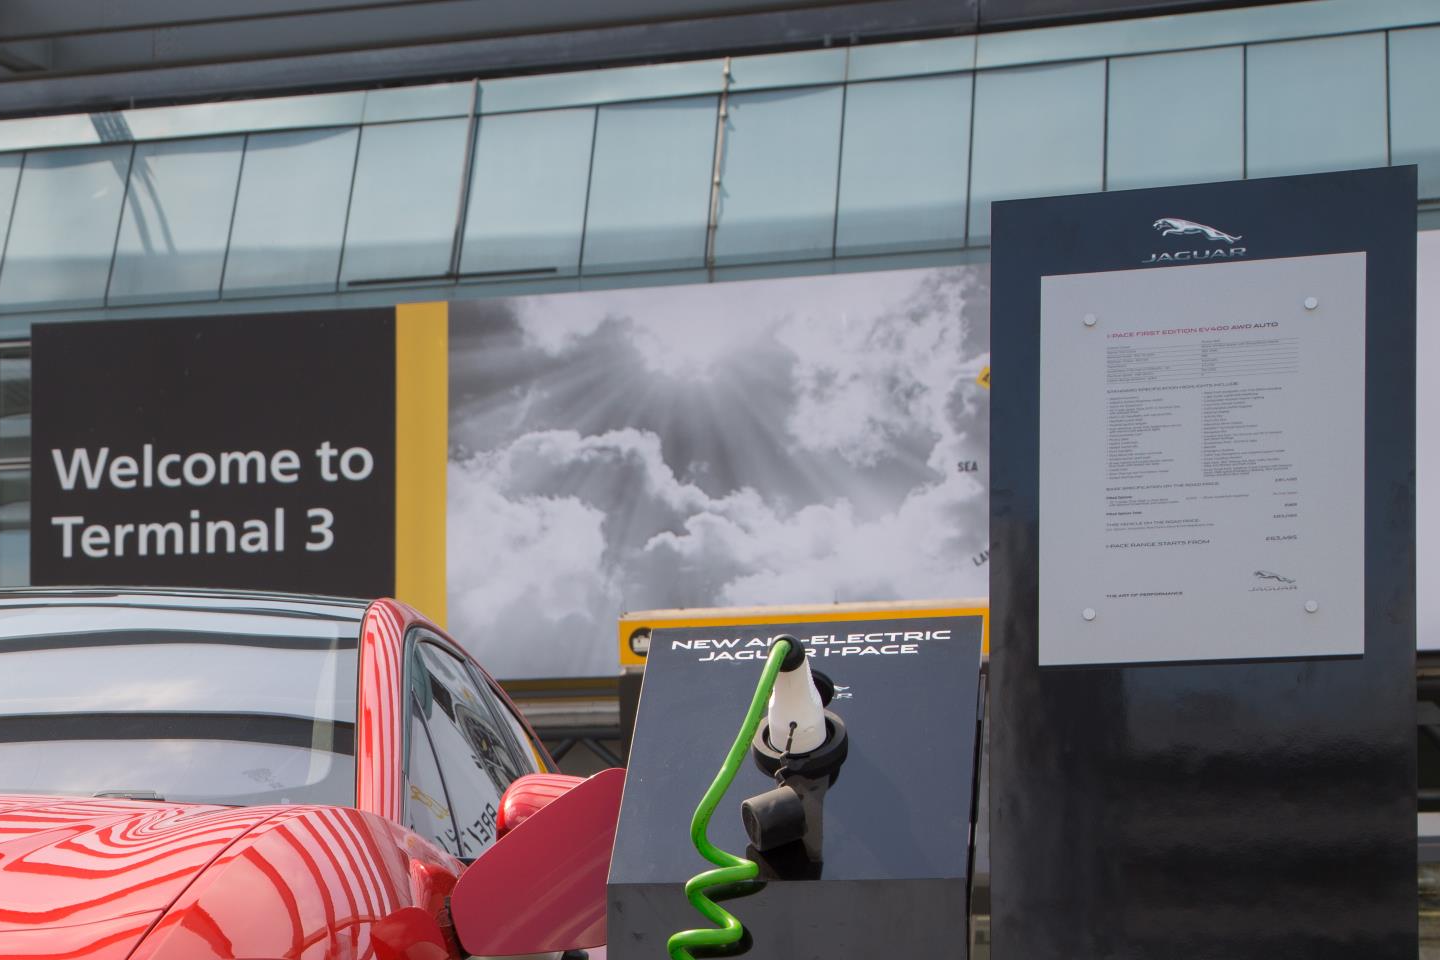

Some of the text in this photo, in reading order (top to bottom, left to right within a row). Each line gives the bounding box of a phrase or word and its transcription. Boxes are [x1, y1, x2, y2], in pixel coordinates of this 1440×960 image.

[1141, 247, 1246, 263] JAGUAR
[1136, 330, 1160, 338] FIRST
[1162, 327, 1197, 336] EDITION
[1199, 325, 1229, 333] EV400
[1253, 321, 1279, 329] AUTO
[51, 441, 374, 490] Welcome to
[957, 461, 978, 472] SEA
[51, 507, 335, 558] Terminal 3
[671, 638, 741, 650] NEW
[824, 644, 919, 657] I-PACE
